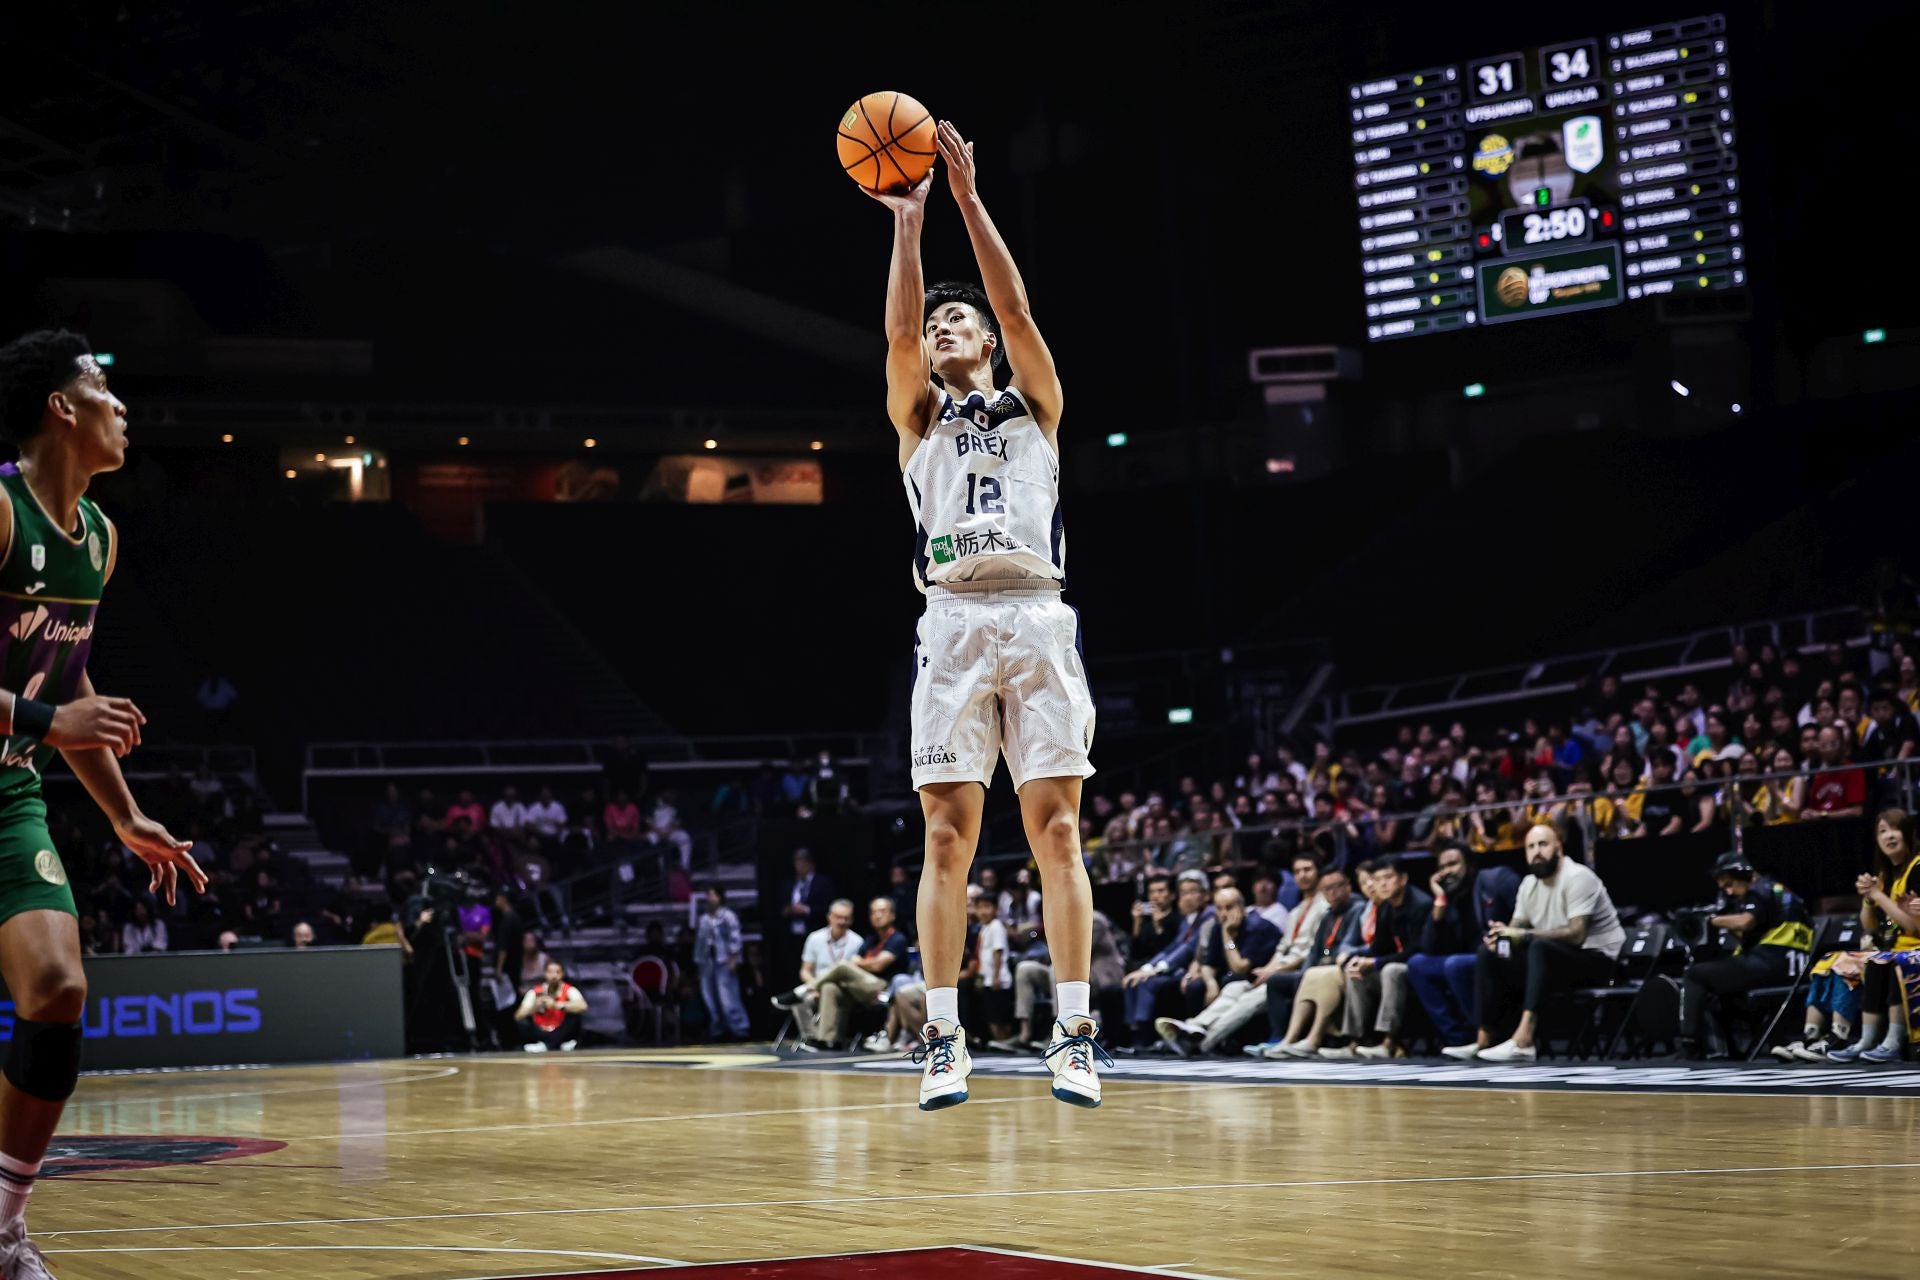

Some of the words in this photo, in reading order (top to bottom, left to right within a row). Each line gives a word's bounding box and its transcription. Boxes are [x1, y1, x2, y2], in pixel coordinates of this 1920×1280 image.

[1478, 61, 1513, 95] 31
[1551, 48, 1590, 82] 34
[1523, 207, 1586, 244] 2:50
[955, 432, 1009, 461] BREX
[965, 472, 1005, 515] 12
[81, 987, 262, 1039] UENOS
